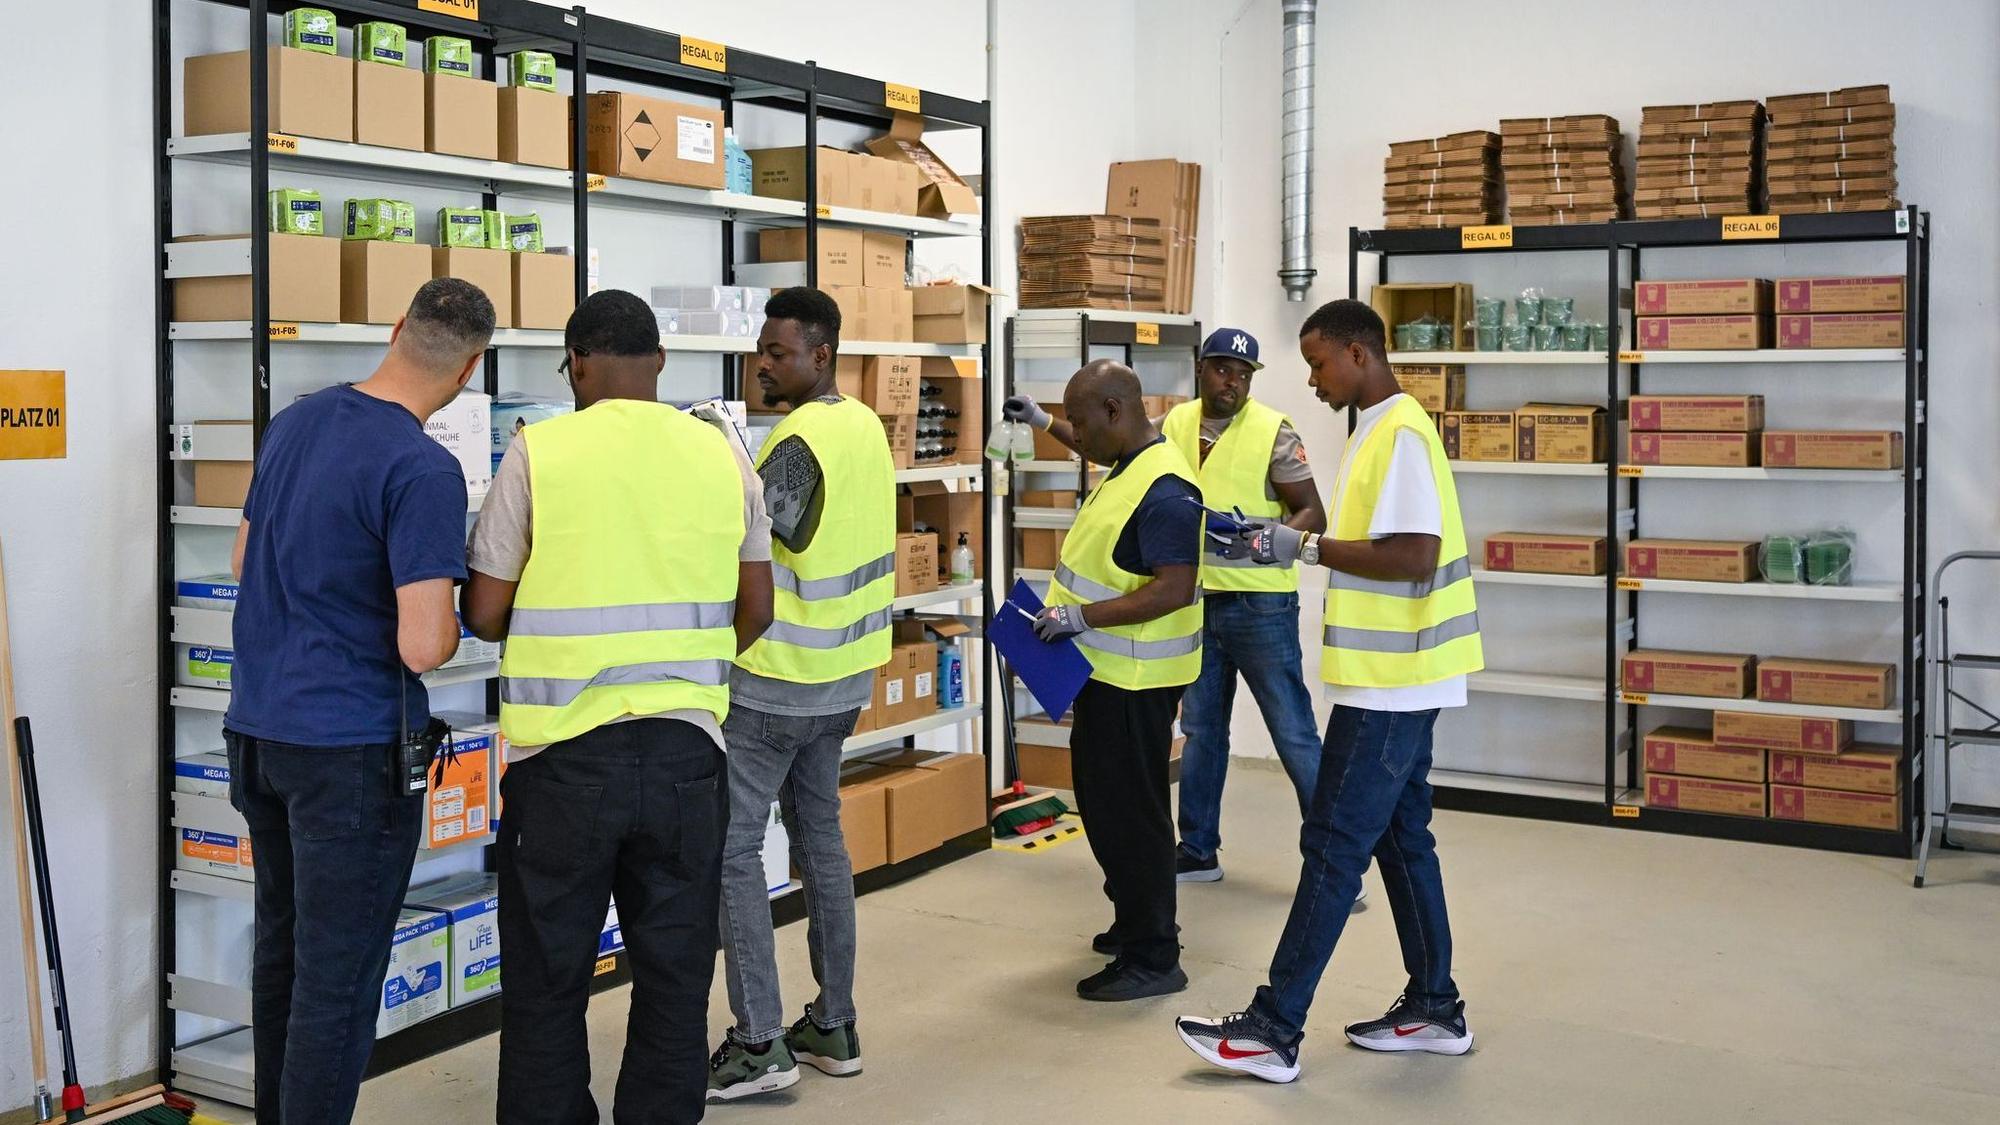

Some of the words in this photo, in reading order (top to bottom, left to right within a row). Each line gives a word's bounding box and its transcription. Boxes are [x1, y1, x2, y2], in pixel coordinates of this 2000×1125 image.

[682, 44, 713, 61] REGAL
[714, 51, 725, 63] 02
[887, 89, 910, 104] REGAL
[1724, 222, 1763, 232] REGAL
[1765, 221, 1778, 231] 06
[1464, 232, 1498, 241] REGAL
[1500, 232, 1511, 240] 05
[1231, 334, 1248, 354] NY
[0, 407, 44, 428] PLATZ
[46, 407, 60, 428] 01
[212, 587, 232, 597] MEGA
[203, 768, 224, 778] MEGA
[484, 898, 499, 910] MEG
[405, 928, 419, 937] PACK
[469, 931, 493, 951] LIFE
